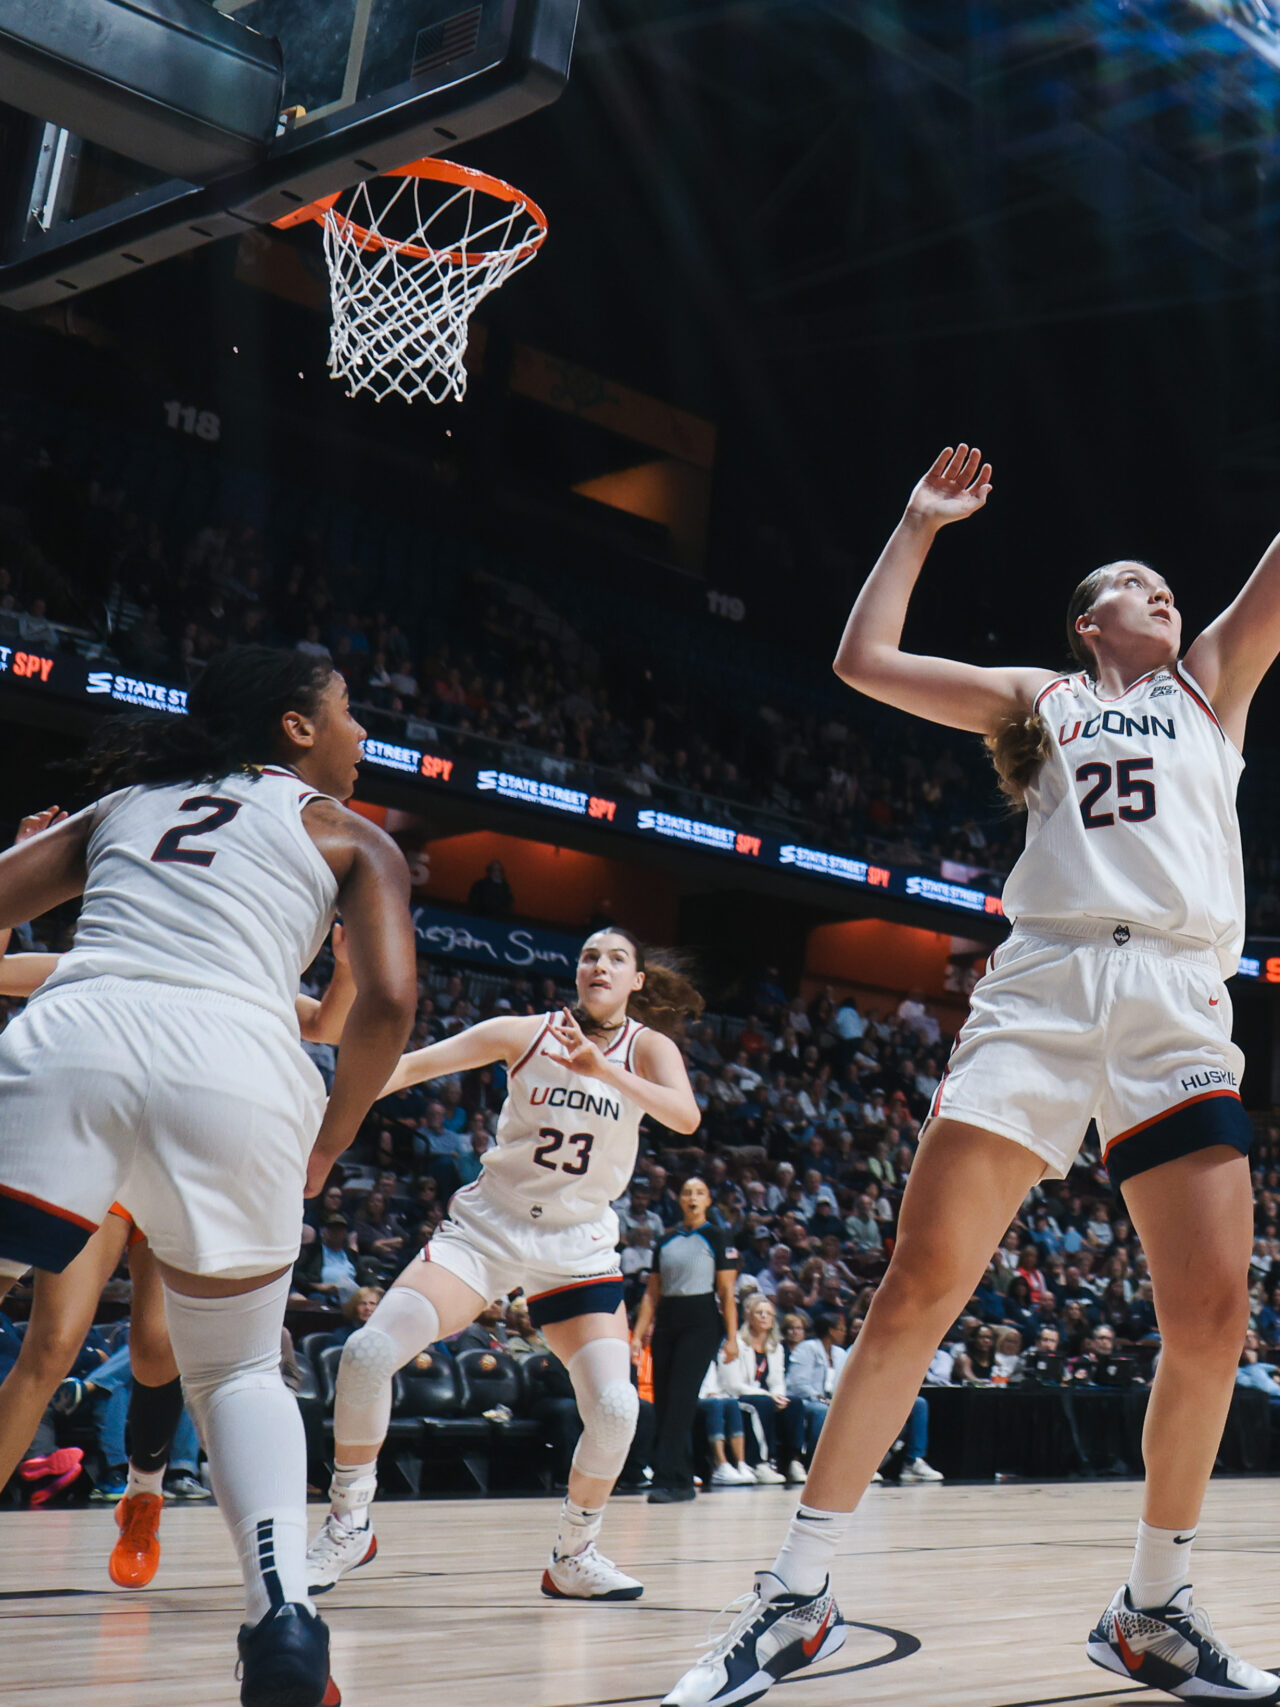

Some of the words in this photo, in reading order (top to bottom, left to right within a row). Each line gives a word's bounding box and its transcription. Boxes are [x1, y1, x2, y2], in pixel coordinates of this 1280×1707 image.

[12, 651, 54, 682] SPY
[114, 676, 167, 702] STATE
[1058, 710, 1177, 746] UCONN
[365, 739, 421, 766] STREET
[421, 755, 454, 782] SPY
[498, 773, 539, 796] STATE
[539, 783, 589, 807] STREET
[588, 796, 617, 822] SPY
[1076, 757, 1156, 830] 25
[151, 795, 243, 867] 2
[736, 833, 762, 857] SPY
[867, 865, 891, 888] SPY
[413, 907, 498, 959] hegan
[504, 930, 569, 967] Sun
[530, 1087, 620, 1121] UCONN
[532, 1127, 594, 1175] 23
